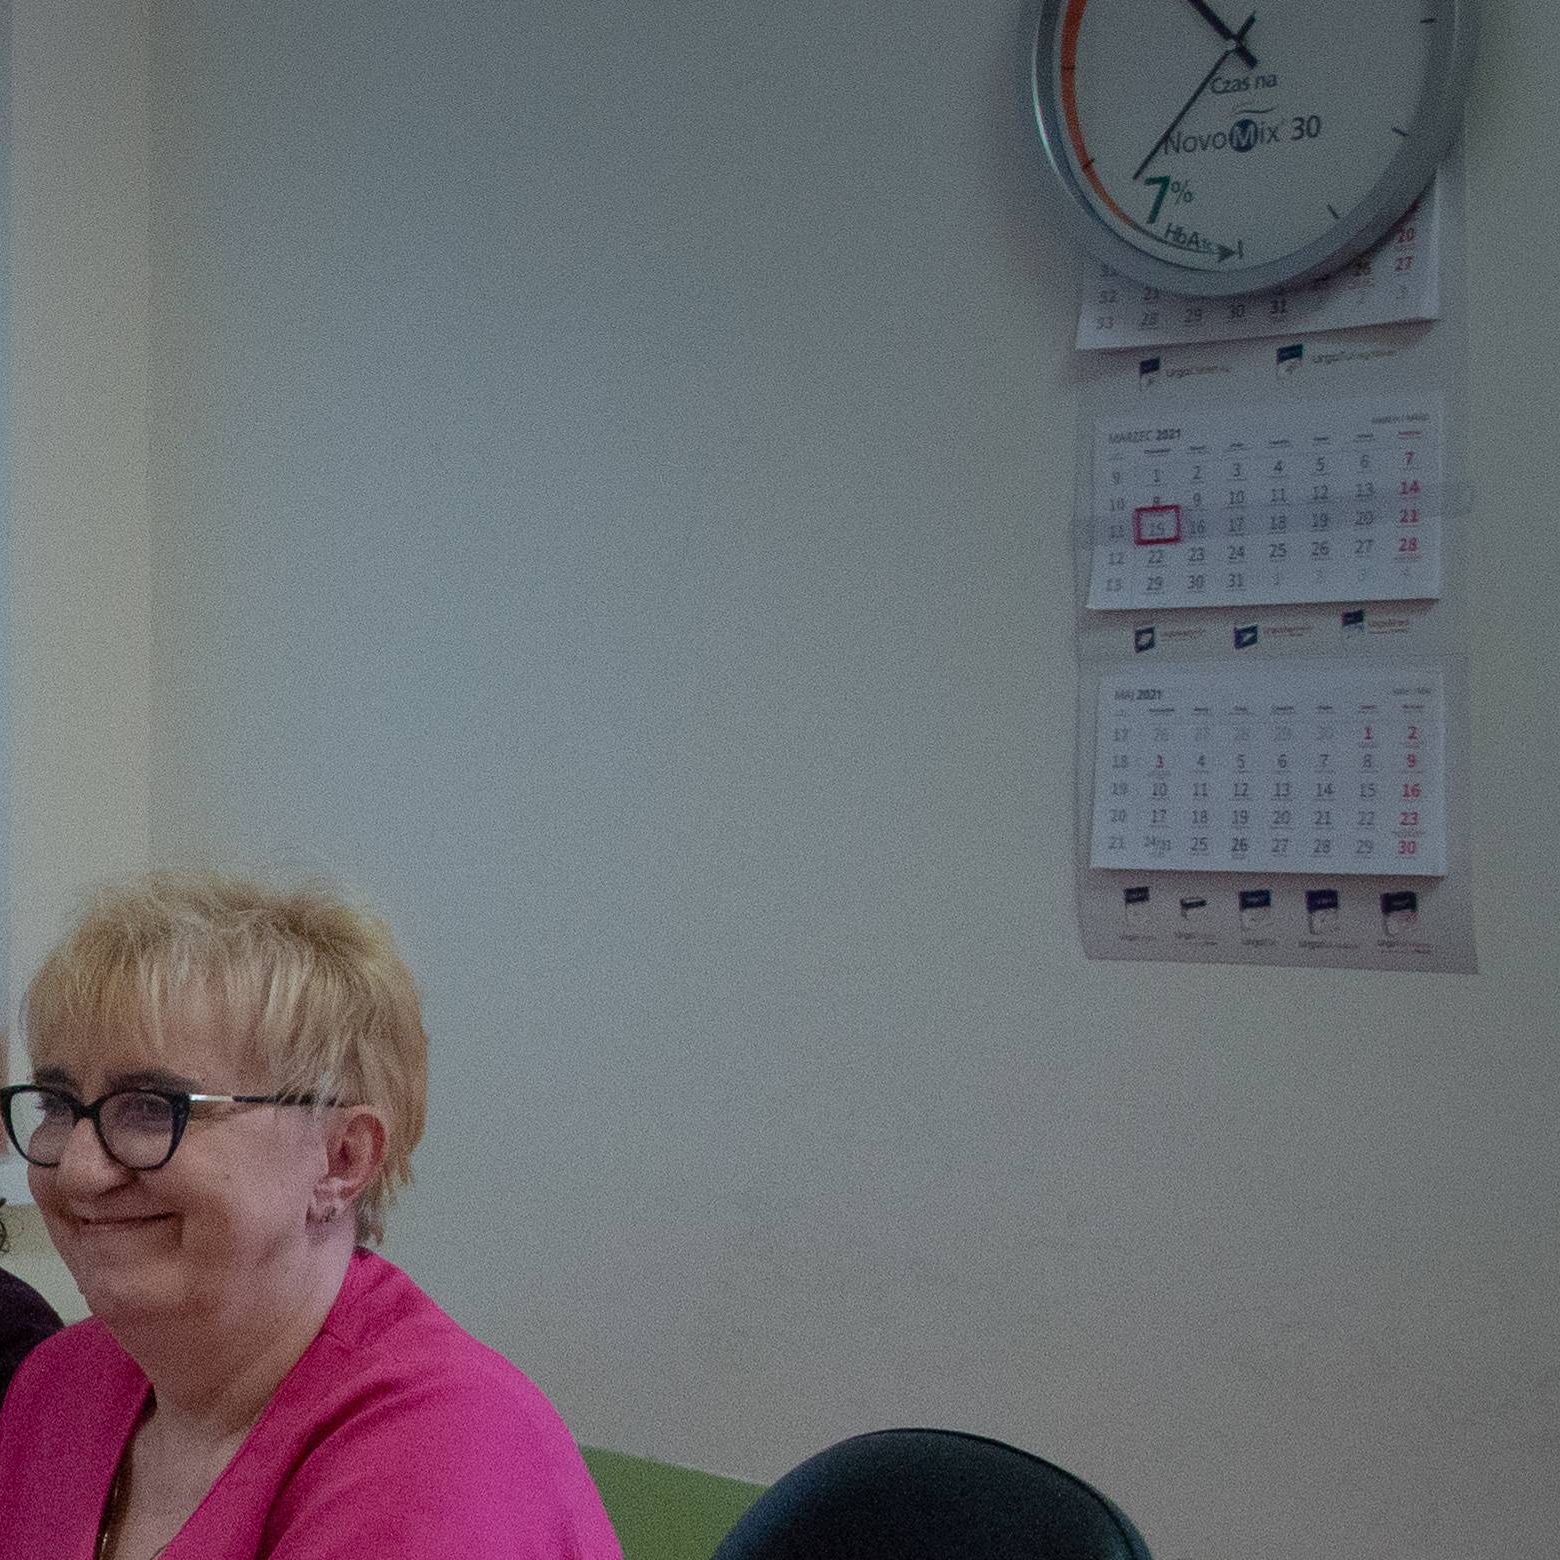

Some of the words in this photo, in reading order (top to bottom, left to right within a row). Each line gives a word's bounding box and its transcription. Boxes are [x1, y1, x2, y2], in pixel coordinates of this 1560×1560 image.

[1210, 77, 1250, 95] Czas
[1255, 74, 1277, 89] na
[1163, 118, 1279, 155] NovoMix
[1291, 115, 1321, 141] 30
[1398, 228, 1415, 243] 20
[1395, 256, 1413, 271] 27
[1185, 309, 1202, 322] 29
[1229, 305, 1245, 318] 30
[1270, 299, 1287, 313] 31
[1108, 430, 1153, 444] MARZEC
[1156, 428, 1181, 441] 2021
[1153, 470, 1161, 483] 1
[1193, 466, 1201, 479] 2
[1233, 463, 1242, 477] 3
[1274, 460, 1284, 473] 4
[1316, 458, 1325, 472] 5
[1360, 455, 1368, 468] 6
[1405, 452, 1414, 465] 7
[1193, 493, 1202, 506] 9
[1229, 491, 1245, 504] 10
[1271, 488, 1286, 502] 11
[1312, 486, 1329, 500] 12
[1356, 483, 1374, 497] 13
[1400, 481, 1420, 495] 14
[1189, 521, 1205, 534] 16
[1228, 518, 1244, 531] 17
[1270, 516, 1287, 530] 18
[1312, 514, 1329, 528] 19
[1355, 511, 1373, 526] 20
[1400, 509, 1419, 523] 21
[1147, 550, 1164, 563] 22
[1188, 547, 1205, 561] 23
[1228, 546, 1244, 559] 24
[1269, 544, 1287, 558] 25
[1311, 542, 1329, 556] 26
[1355, 539, 1373, 553] 27
[1399, 538, 1418, 552] 28
[1146, 576, 1163, 590] 29
[1187, 575, 1204, 589] 30
[1228, 573, 1245, 587] 31
[1136, 689, 1162, 700] 2021
[1113, 728, 1129, 742] 17
[1364, 726, 1372, 740] 1
[1407, 726, 1417, 740] 2
[1156, 754, 1164, 769] 3
[1197, 755, 1206, 766] 4
[1237, 754, 1245, 769] 5
[1278, 754, 1287, 768] 6
[1319, 754, 1329, 767] 7
[1363, 754, 1373, 768] 8
[1407, 754, 1417, 768] 9
[1112, 782, 1128, 795] 19
[1152, 782, 1168, 796] 10
[1193, 782, 1208, 797] 11
[1233, 782, 1249, 797] 12
[1274, 782, 1291, 797] 13
[1316, 783, 1334, 797] 14
[1359, 783, 1376, 798] 15
[1402, 783, 1421, 798] 16
[1151, 809, 1166, 824] 17
[1192, 810, 1209, 824] 18
[1232, 810, 1249, 824] 19
[1273, 811, 1291, 825] 20
[1315, 811, 1331, 825] 21
[1358, 811, 1375, 826] 22
[1400, 812, 1418, 825] 23
[1191, 837, 1208, 852] 25
[1231, 838, 1249, 852] 26
[1272, 839, 1289, 853] 27
[1314, 839, 1331, 853] 28
[1356, 840, 1373, 854] 29
[1398, 841, 1417, 854] 30
